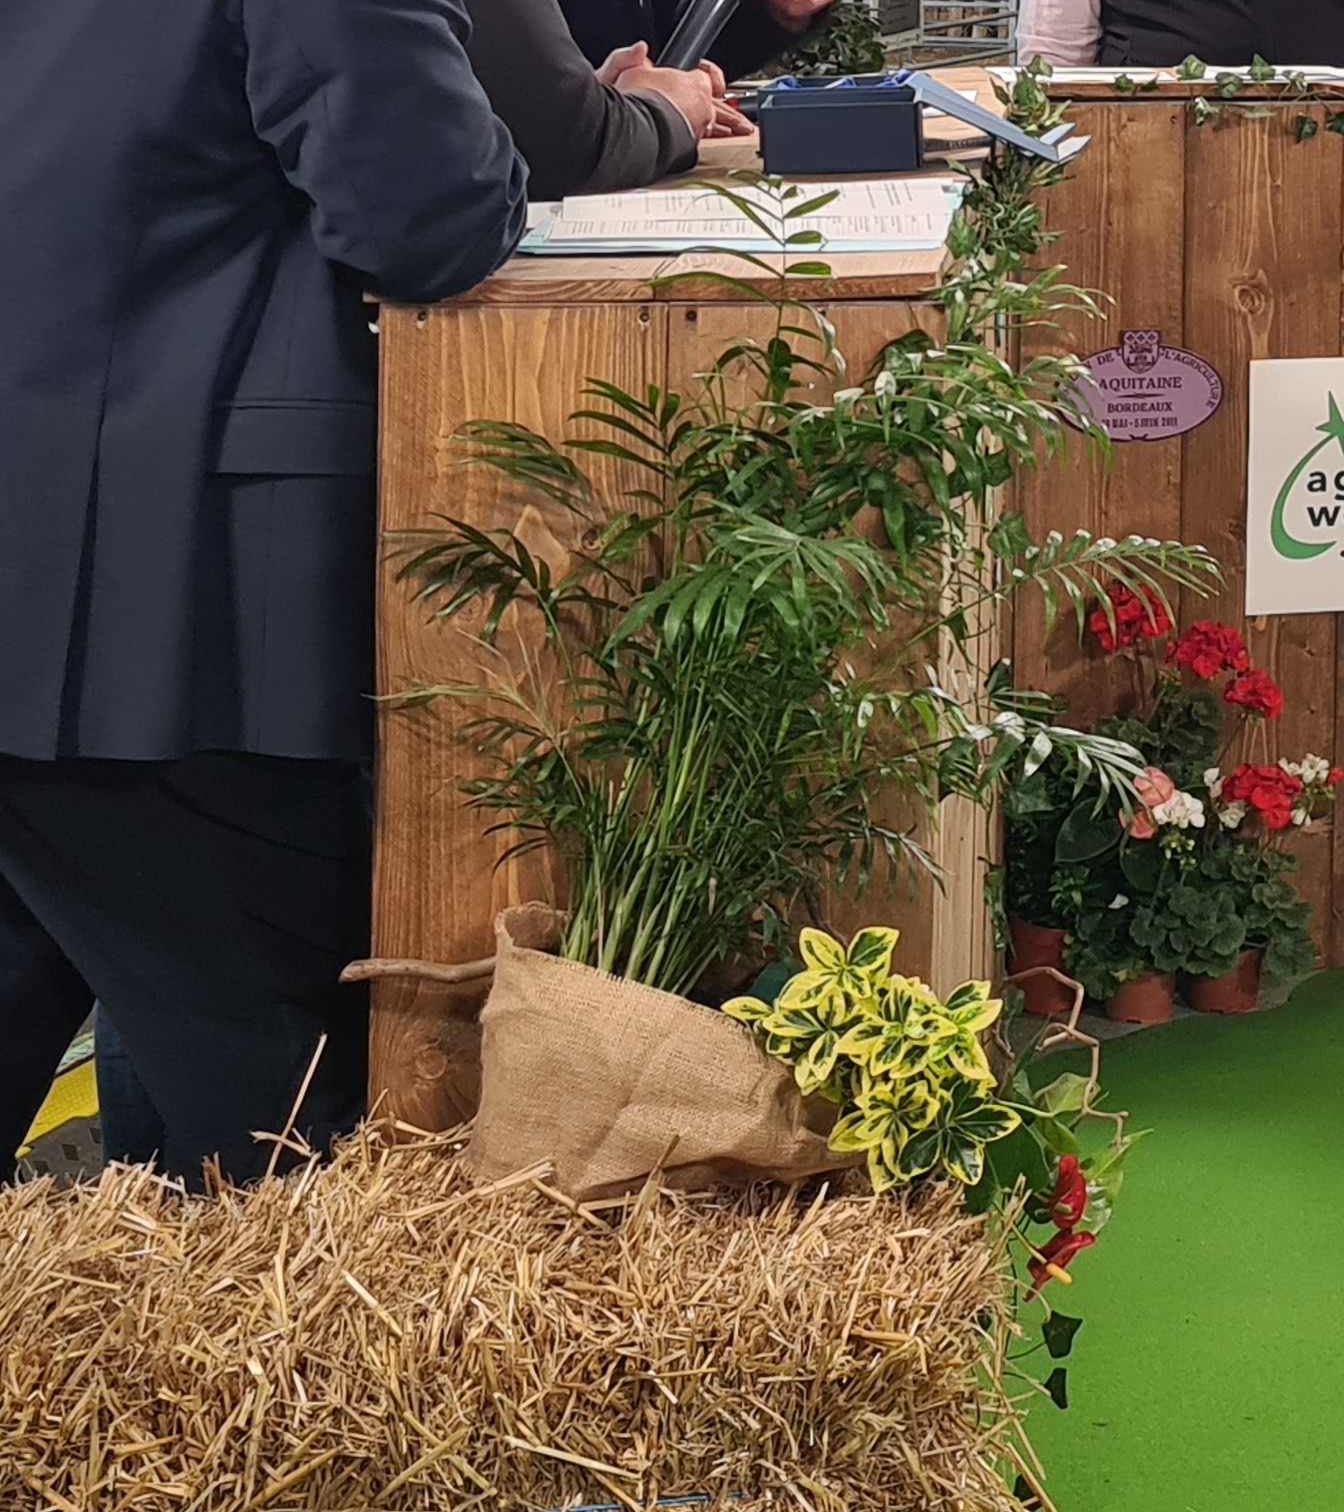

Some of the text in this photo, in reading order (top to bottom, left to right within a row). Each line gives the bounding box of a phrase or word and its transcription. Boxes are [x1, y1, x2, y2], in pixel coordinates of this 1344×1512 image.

[1097, 349, 1220, 409] DE L'AGRICULTURE
[1098, 376, 1183, 392] AQUITAINE
[1107, 401, 1173, 414] BORDEAUX
